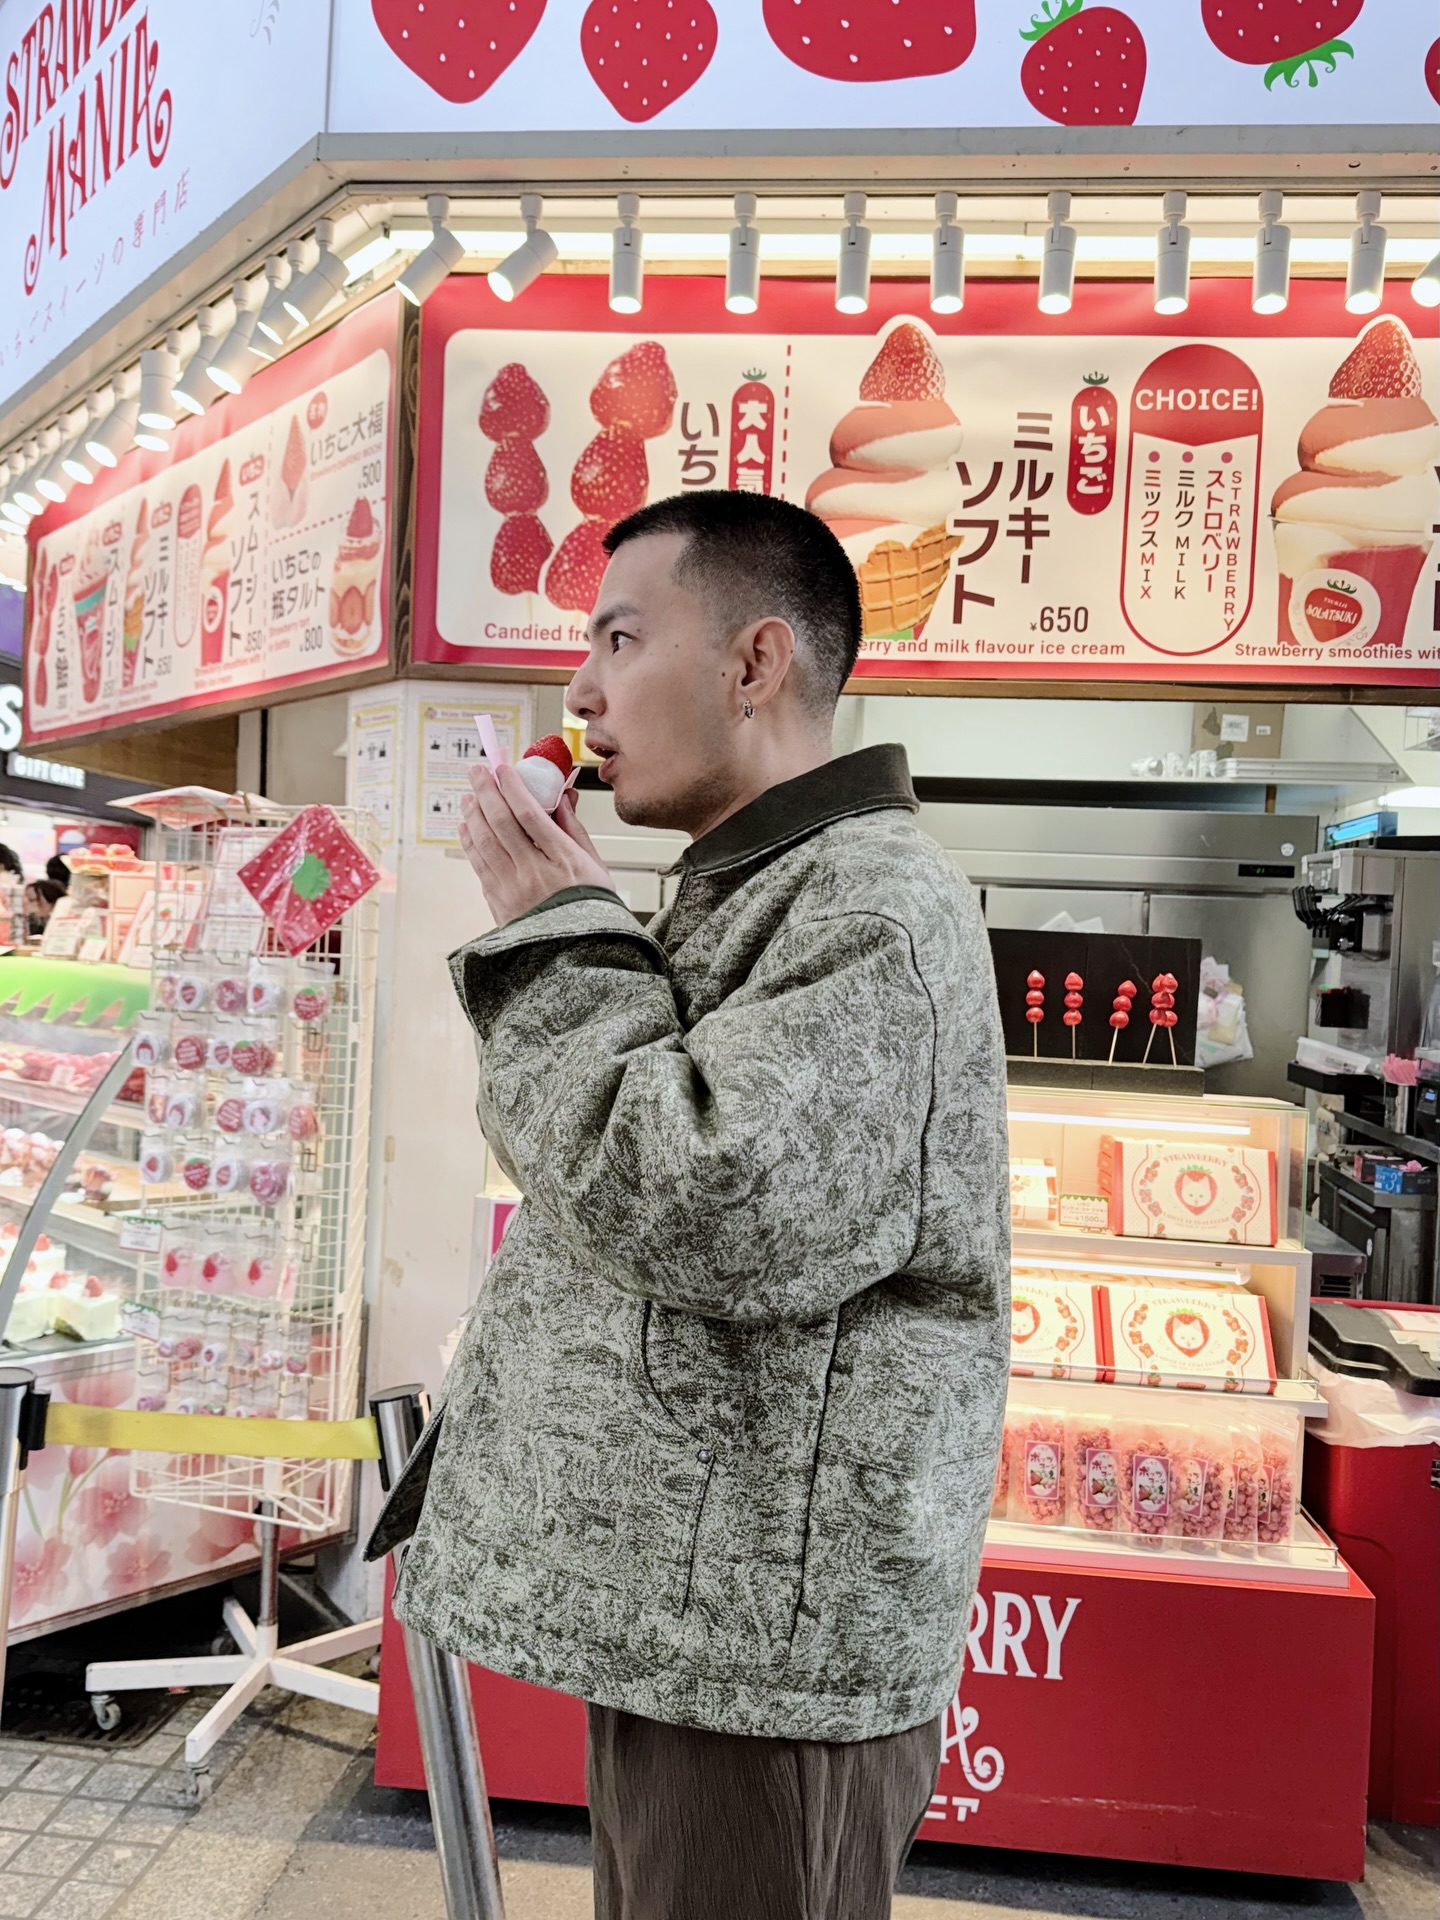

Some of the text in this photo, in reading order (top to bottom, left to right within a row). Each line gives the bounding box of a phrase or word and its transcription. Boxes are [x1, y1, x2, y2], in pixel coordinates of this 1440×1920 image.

[0, 0, 137, 190] STRAW
[24, 6, 172, 296] MANIA
[311, 401, 385, 466] いちご大福
[1135, 388, 1259, 411] CHOICE!
[678, 402, 720, 495] いち
[1076, 405, 1110, 495] いちご
[952, 461, 1004, 625] ソフト
[1006, 412, 1054, 584] ミルキー
[1140, 470, 1162, 600] ミックス MIX
[1174, 470, 1196, 600] ミルク MILK
[1202, 470, 1226, 593] ストロベリー
[229, 535, 245, 657] ソフト
[272, 550, 322, 584] いちごの
[1223, 470, 1243, 632] STRAWBERRY
[143, 568, 157, 679] ソフト
[484, 622, 588, 642] Candied fr
[897, 639, 928, 653] and
[934, 640, 969, 653] milk
[975, 640, 1035, 654] flavour
[1040, 640, 1065, 655] ice
[1071, 644, 1125, 655] cream
[1235, 642, 1324, 660] Strawberry
[1328, 645, 1413, 660] smoothies
[1305, 604, 1359, 624] SOLATSUKI
[14, 755, 85, 788] GIFT GATE
[1163, 1152, 1227, 1167] STRAWBERRY
